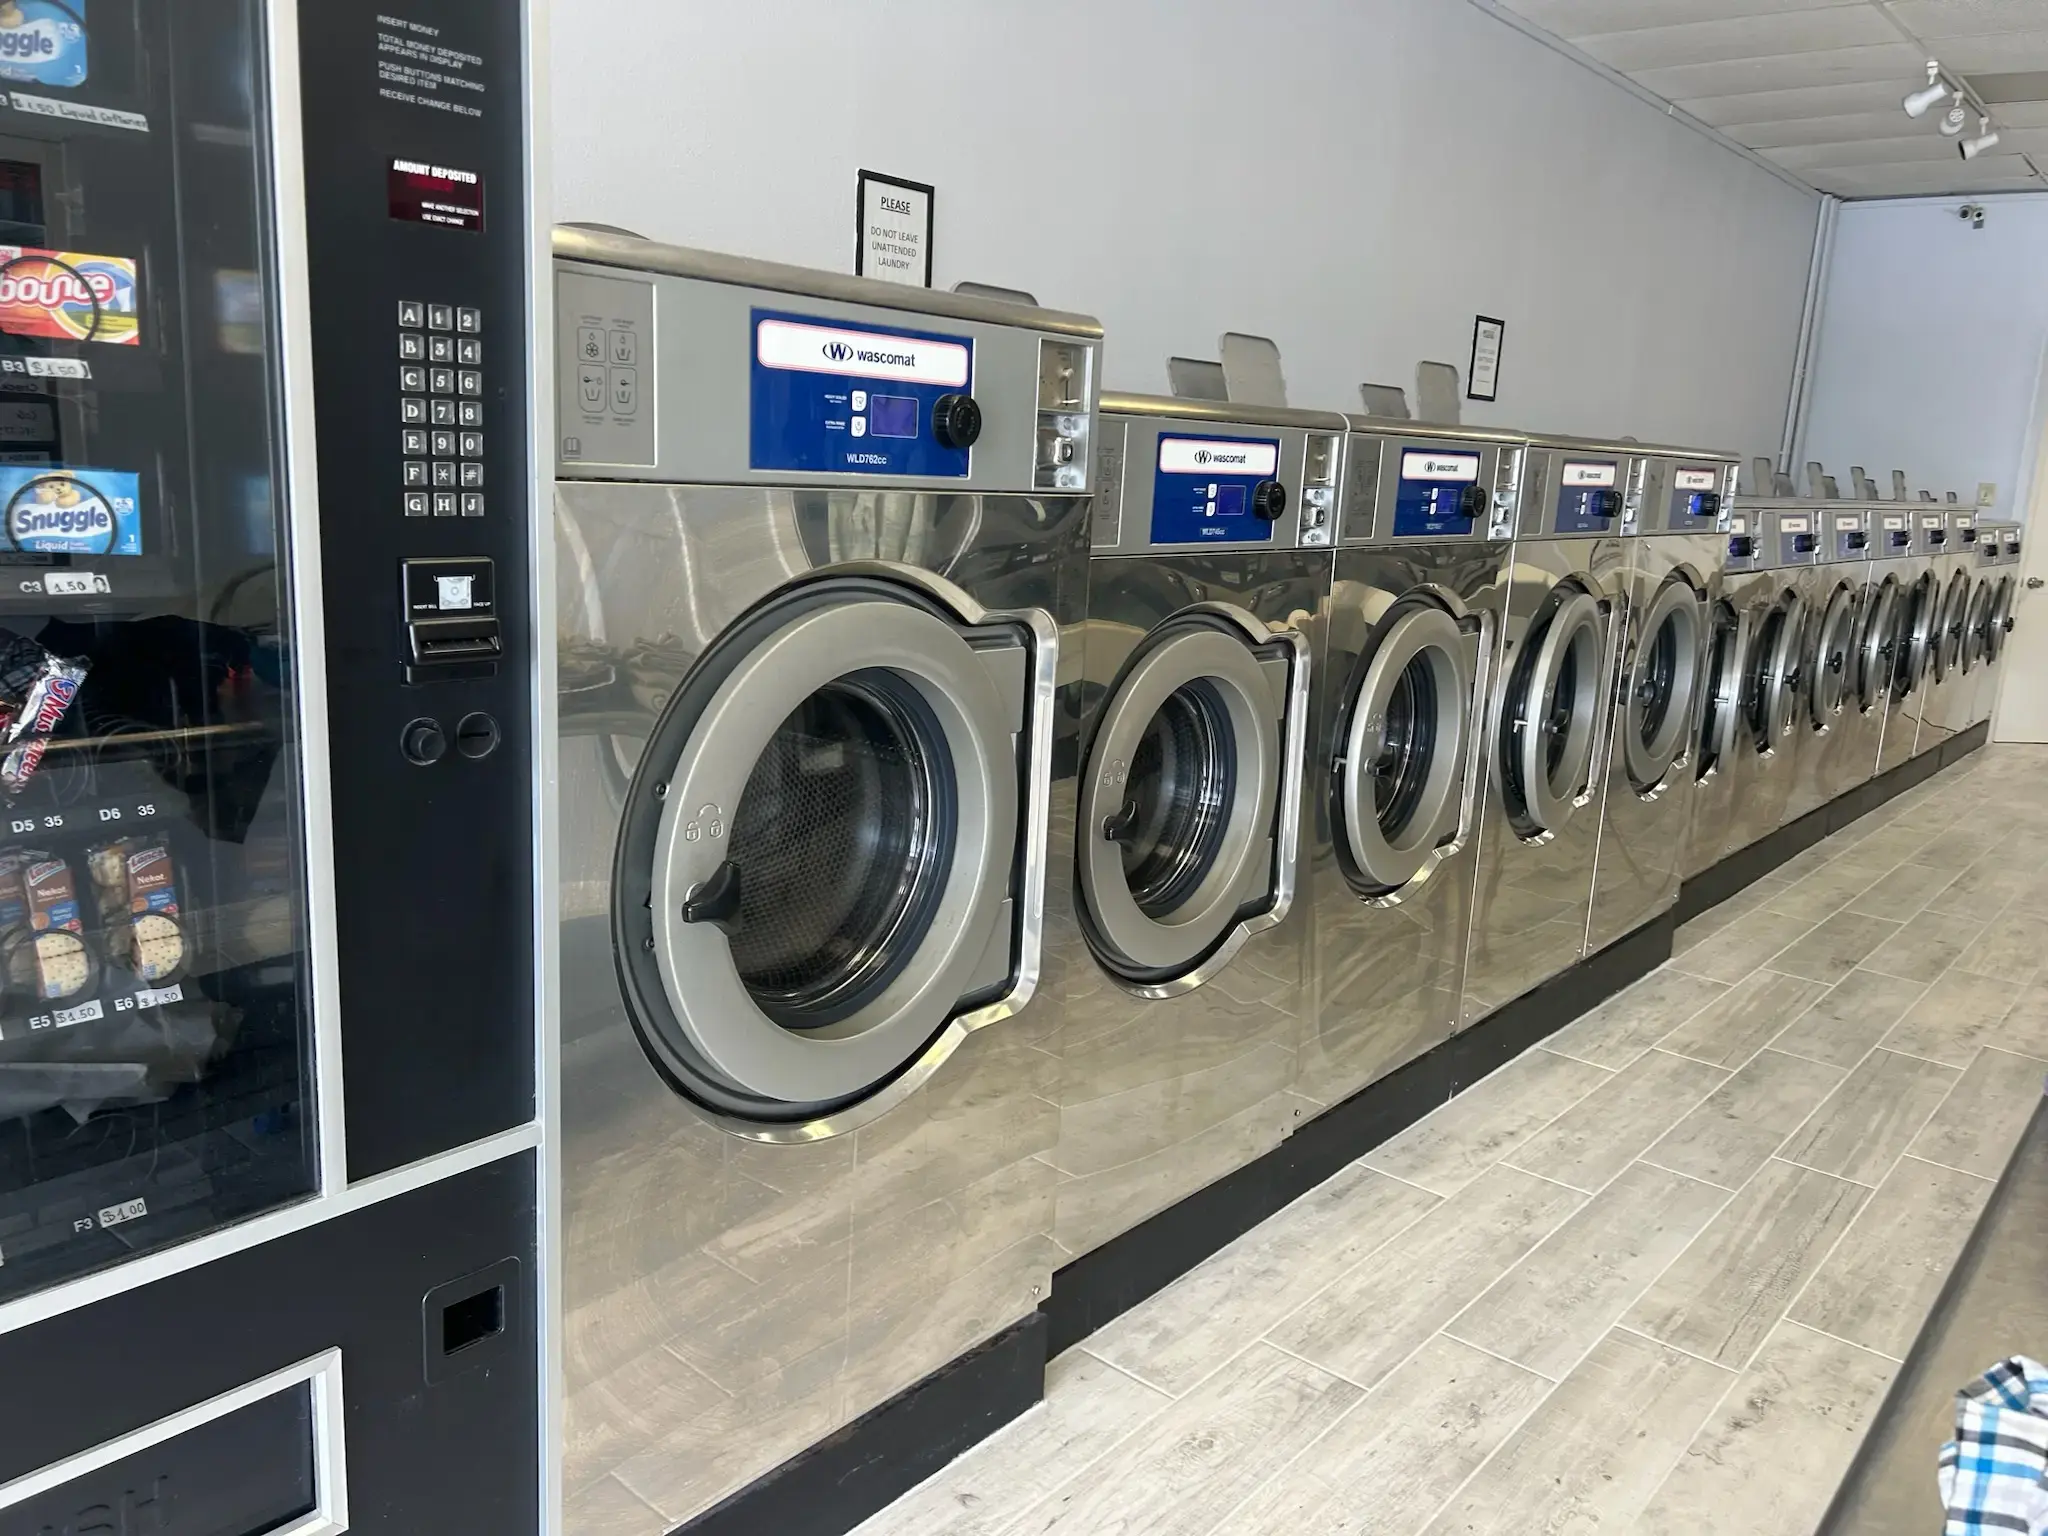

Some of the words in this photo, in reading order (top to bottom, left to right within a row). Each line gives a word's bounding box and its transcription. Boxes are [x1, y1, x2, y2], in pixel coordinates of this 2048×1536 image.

[377, 15, 407, 29] INSERT
[409, 22, 439, 36] MONEY
[0, 30, 54, 57] ggle
[378, 33, 404, 47] TOTAL
[406, 40, 436, 54] MONEY
[437, 48, 482, 66] DEPOSITED
[378, 42, 418, 58] APPEARS
[420, 52, 428, 61] IN
[430, 54, 464, 70] DISPLAY
[378, 61, 402, 74] PUSH
[404, 66, 442, 82] BUTTONS
[444, 75, 485, 92] MATCHING
[379, 71, 416, 86] DESIRED
[417, 79, 437, 90] ITEM
[379, 89, 416, 104] RECEIVE
[417, 96, 451, 111] CHANGE
[453, 104, 482, 117] BELOW
[394, 160, 430, 176] AMOUNT
[432, 165, 477, 184] DEPOSITED
[881, 196, 910, 213] PLEASE
[871, 226, 881, 236] DO
[883, 229, 896, 239] NOT
[899, 232, 918, 244] LEAVE
[872, 242, 916, 258] UNATTENDED
[878, 257, 910, 270] LAUNDRY
[403, 309, 416, 322] A
[435, 312, 442, 324] 1
[463, 314, 472, 326] 2
[405, 340, 416, 354] B
[436, 344, 444, 356] 3
[464, 346, 472, 358] 4
[2, 360, 25, 372] B3
[857, 349, 916, 367] wascomat
[405, 372, 417, 386] C
[436, 375, 445, 387] 5
[464, 377, 473, 389] 6
[407, 405, 418, 418] D
[437, 406, 446, 418] 7
[465, 408, 474, 420] 8
[408, 436, 419, 449] E
[438, 438, 447, 450] 9
[466, 438, 474, 450] 0
[846, 454, 887, 465] WLD762cc
[1213, 454, 1246, 464] wascomat
[409, 468, 420, 480] F
[409, 499, 422, 511] G
[438, 499, 450, 511] H
[467, 499, 475, 510] J
[16, 506, 108, 534] Snuggle
[35, 540, 69, 552] Liquid
[129, 534, 135, 543] 1
[20, 581, 42, 593] C3
[50, 679, 74, 700] 3
[99, 808, 121, 821] D6
[138, 804, 156, 816] 35
[12, 819, 35, 833] D5
[44, 815, 63, 828] 35
[114, 998, 134, 1012] E6
[29, 1016, 51, 1030] E5
[56, 1007, 96, 1024] $1.50
[73, 1217, 93, 1232] F3
